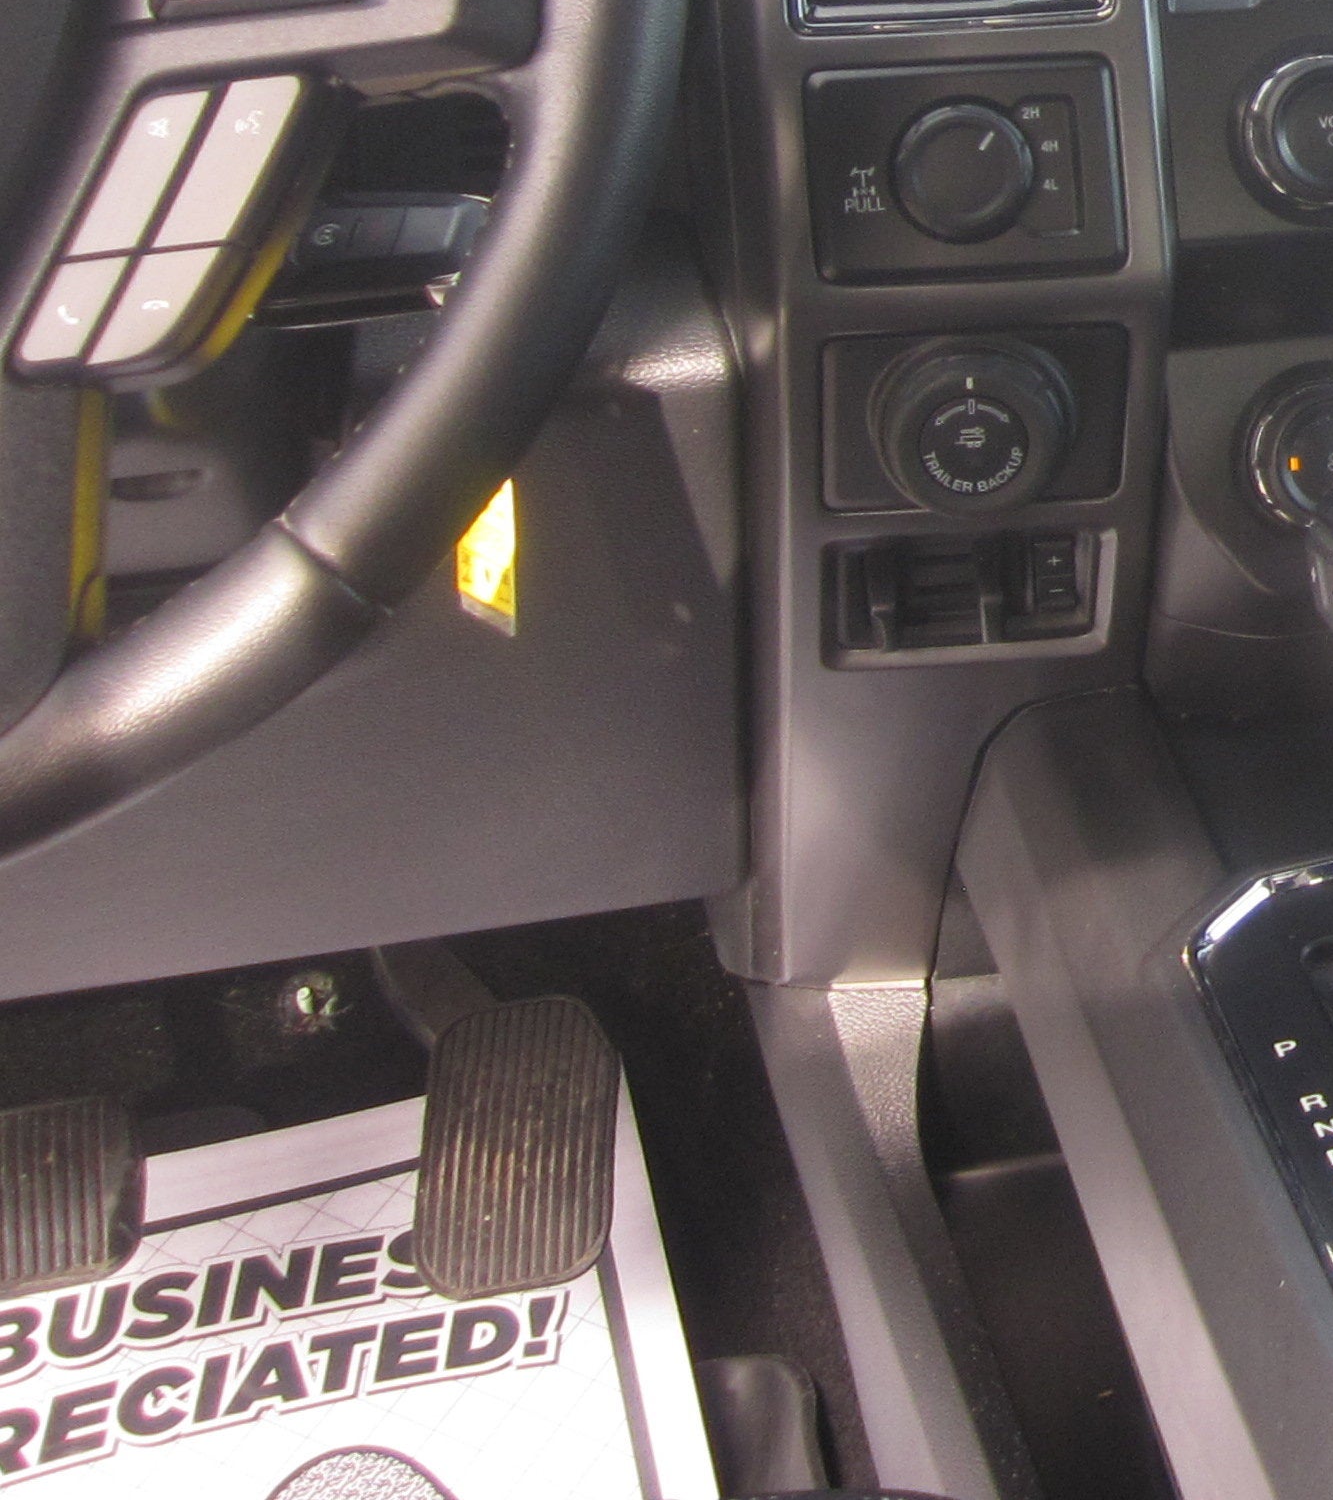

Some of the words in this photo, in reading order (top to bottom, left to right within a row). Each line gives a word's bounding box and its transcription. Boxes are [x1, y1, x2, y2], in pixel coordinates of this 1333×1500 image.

[1022, 106, 1040, 120] 2H
[1041, 140, 1059, 152] 4H
[1043, 178, 1059, 191] 4L
[844, 196, 886, 214] PULL
[922, 450, 974, 493] TRAILER
[976, 446, 1023, 493] BACKUP
[1273, 1039, 1297, 1058] P
[1300, 1093, 1328, 1113] R
[0, 1231, 431, 1377] BUSINES
